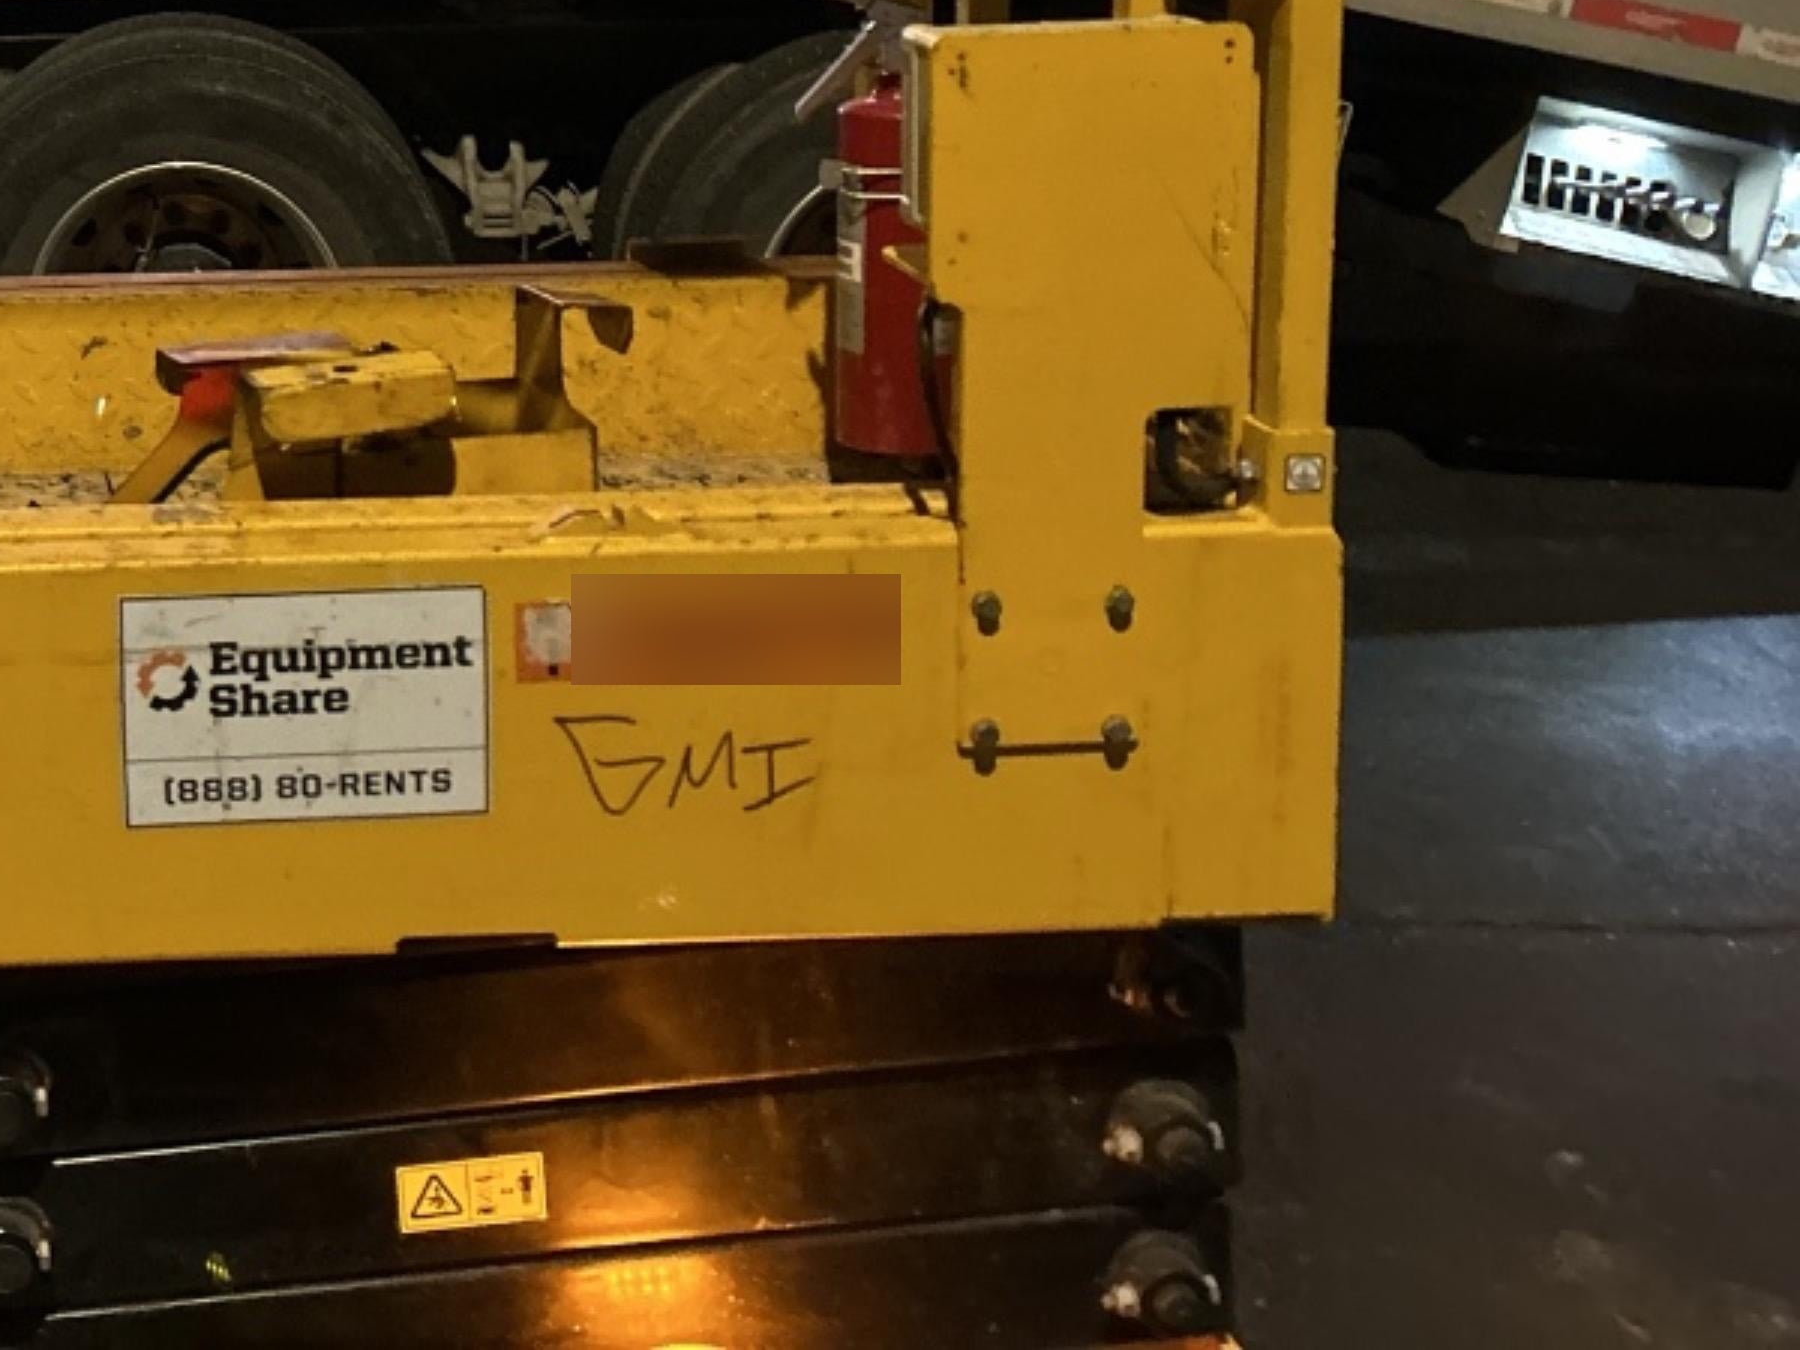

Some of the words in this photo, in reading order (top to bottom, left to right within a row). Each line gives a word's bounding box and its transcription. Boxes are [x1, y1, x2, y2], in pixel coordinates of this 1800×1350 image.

[209, 634, 474, 679] Equipment
[209, 681, 351, 718] Share
[164, 777, 262, 805] (888)
[277, 768, 453, 800] 80-RENTS
